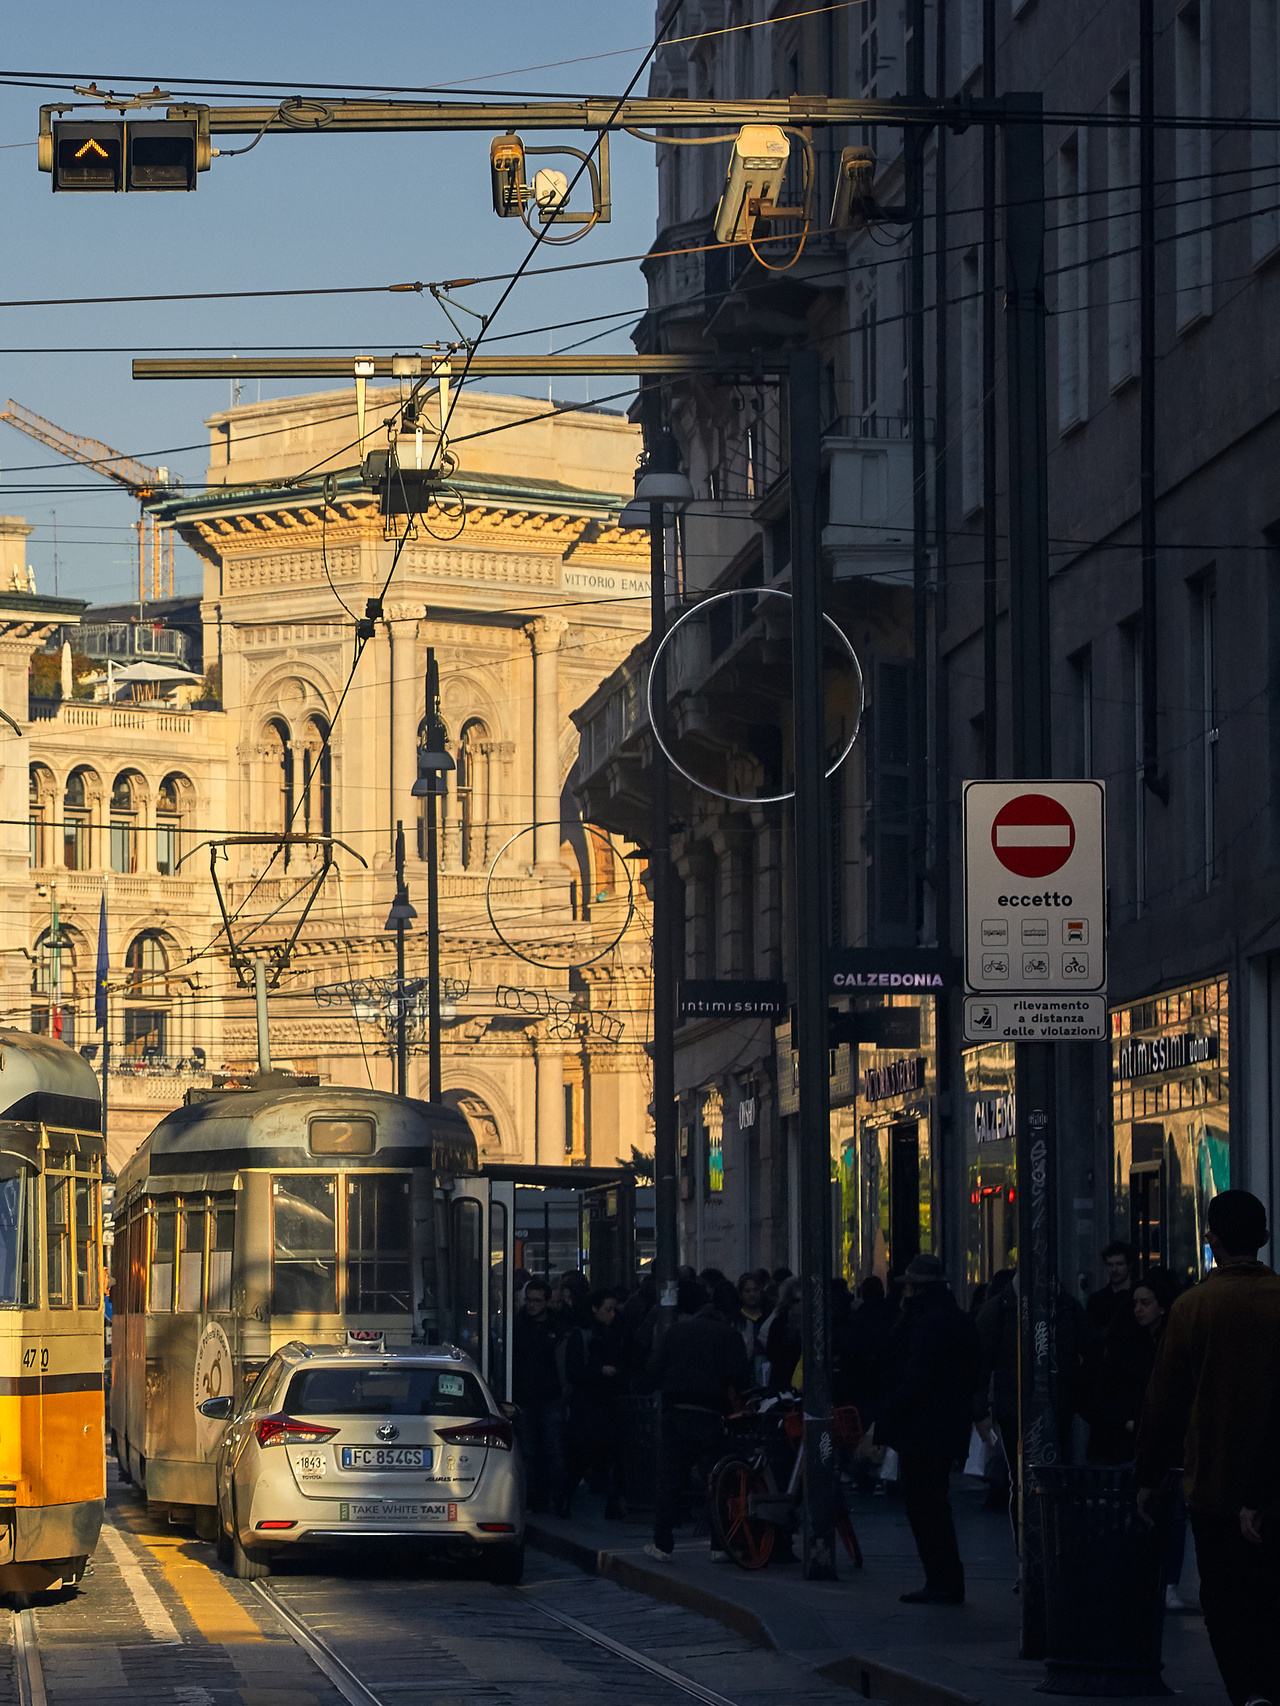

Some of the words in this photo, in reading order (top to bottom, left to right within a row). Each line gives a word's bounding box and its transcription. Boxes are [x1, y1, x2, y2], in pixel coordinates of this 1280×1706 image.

[564, 573, 616, 589] VITTORIO
[997, 891, 1073, 907] eccetto
[833, 973, 944, 987] CALZEDONIA
[681, 1000, 781, 1013] intimissimi
[1013, 1001, 1090, 1011] rilevamento
[1018, 1015, 1026, 1024] a
[1031, 1013, 1085, 1024] distanza
[1002, 1026, 1035, 1037] delle
[1040, 1026, 1100, 1037] violazioni
[1189, 1036, 1209, 1063] uomo
[329, 1121, 353, 1153] 2
[351, 1331, 381, 1340] TAXI
[22, 1347, 50, 1368] 470
[300, 1457, 322, 1469] 1843
[353, 1450, 372, 1465] FC
[376, 1450, 422, 1465] 854GS
[352, 1505, 379, 1514] TAKE
[382, 1505, 418, 1514] WHITE
[420, 1505, 446, 1514] TAXI
